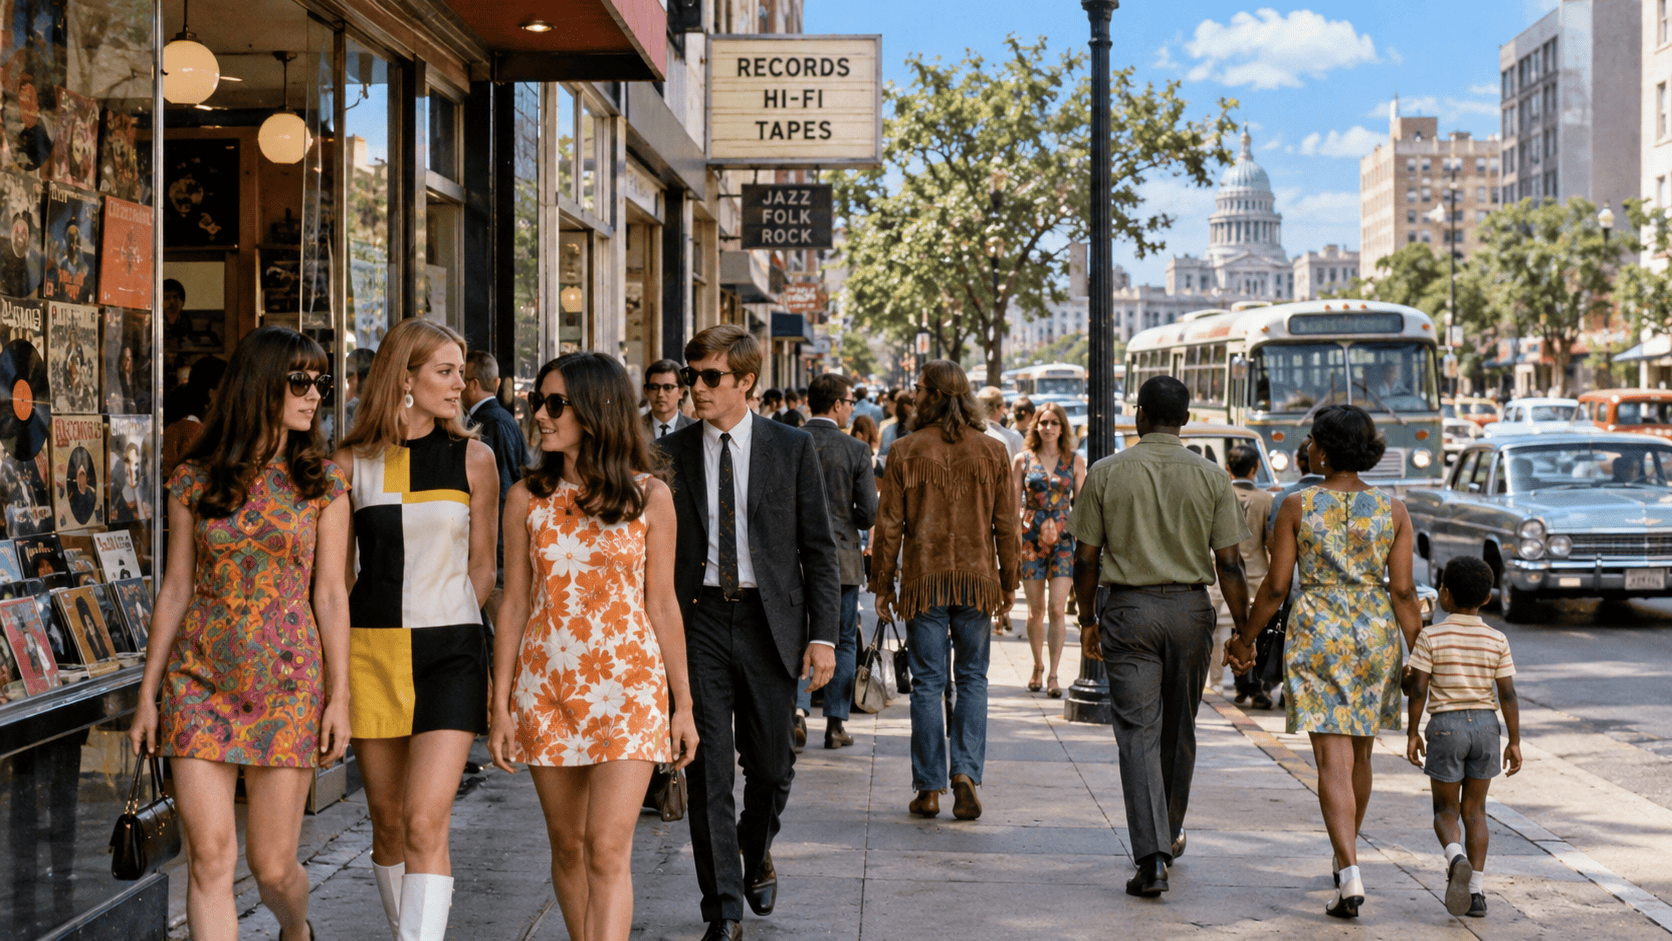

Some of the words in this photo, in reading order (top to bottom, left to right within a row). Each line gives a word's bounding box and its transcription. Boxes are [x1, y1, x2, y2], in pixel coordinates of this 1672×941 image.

[737, 57, 850, 77] RECORDS
[763, 89, 823, 108] HI-FI
[755, 121, 832, 140] TAPES
[762, 190, 811, 205] JAZZ
[762, 209, 811, 224] FOLK
[762, 229, 812, 244] ROCK
